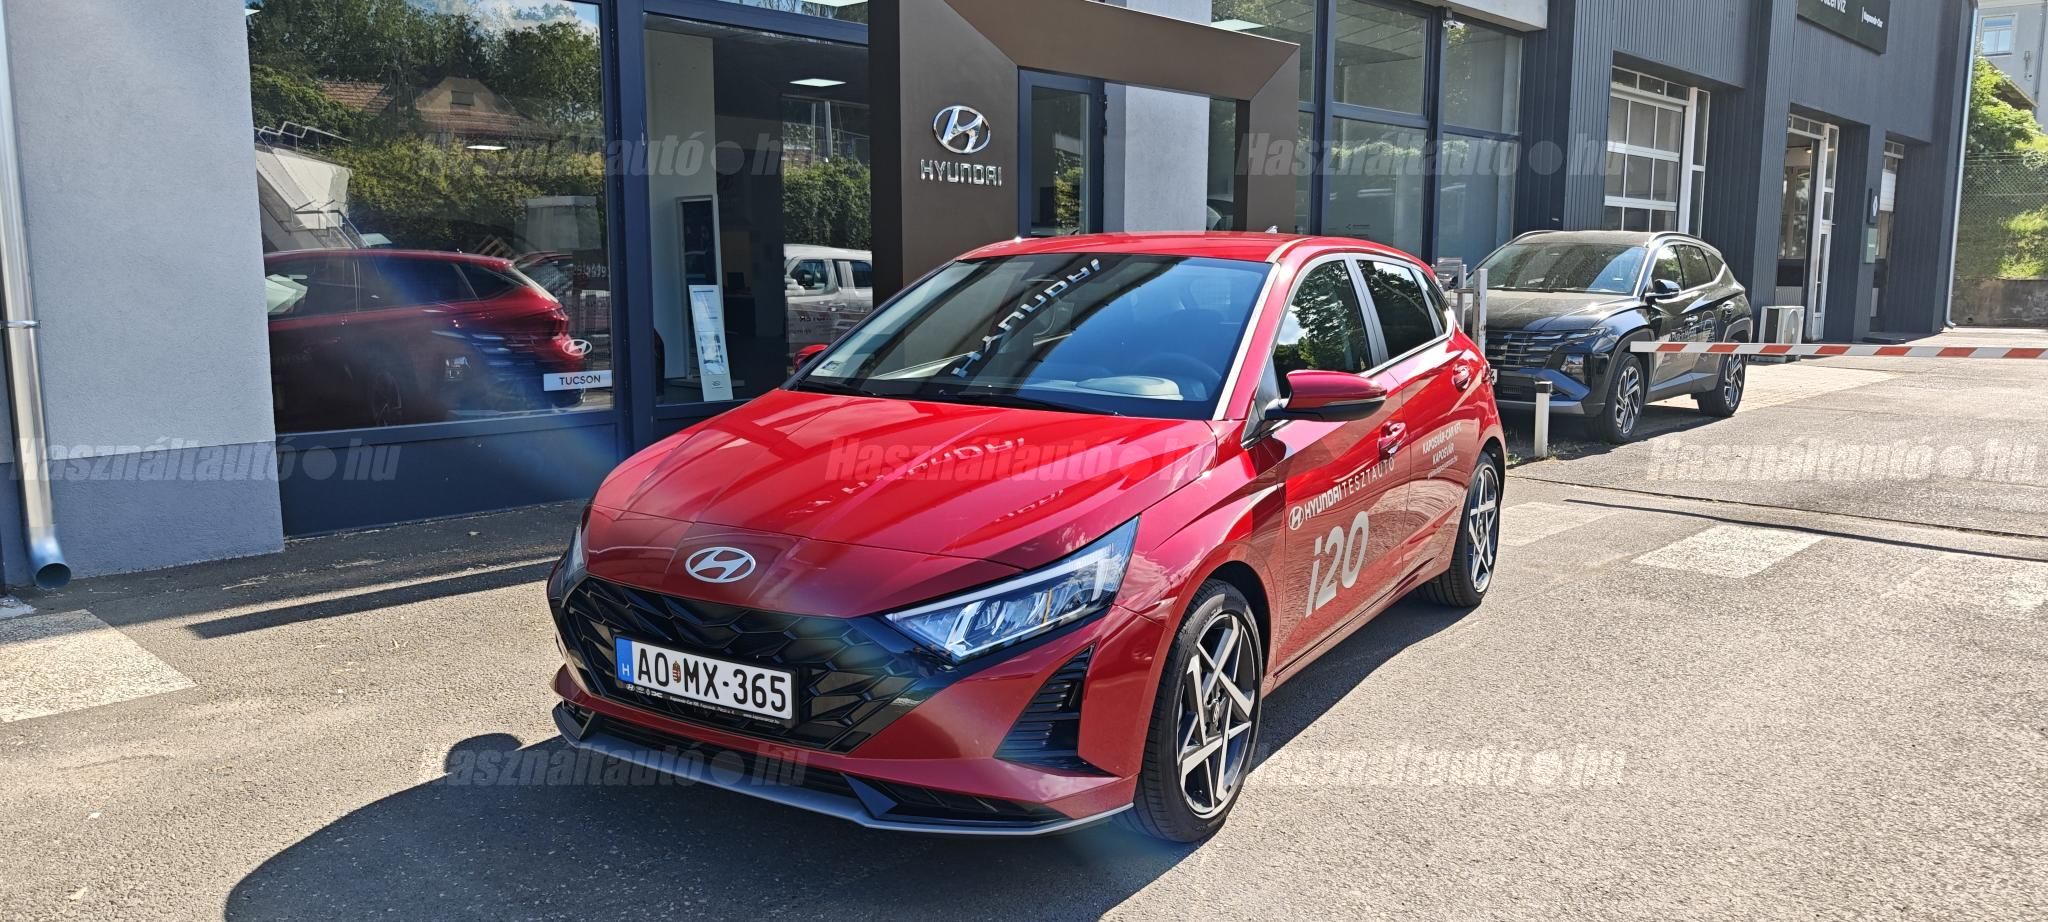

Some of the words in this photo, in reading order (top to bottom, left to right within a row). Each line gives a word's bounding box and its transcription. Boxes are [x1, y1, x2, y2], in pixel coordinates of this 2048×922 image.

[920, 159, 1002, 187] HYUNDAI
[558, 375, 601, 386] TUCSON
[1304, 485, 1342, 521] HYUNDAI
[1305, 510, 1370, 618] i20
[621, 663, 631, 677] H
